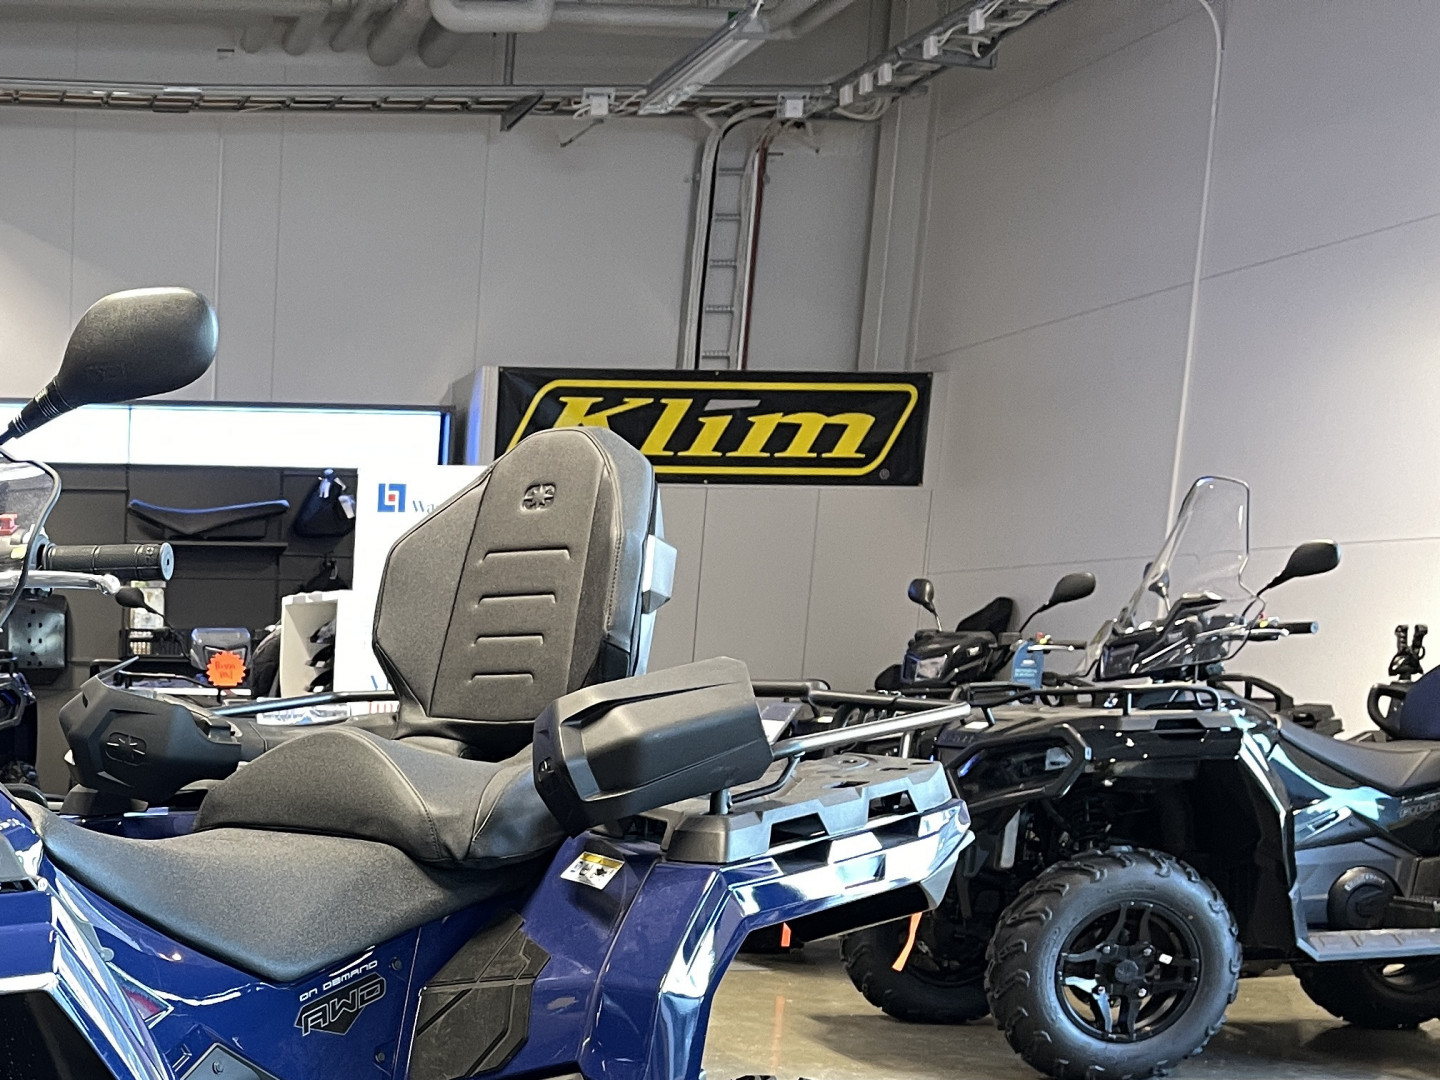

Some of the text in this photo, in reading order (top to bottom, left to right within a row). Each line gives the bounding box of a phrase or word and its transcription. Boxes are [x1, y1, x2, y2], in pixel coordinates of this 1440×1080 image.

[299, 960, 378, 1002] ON DEMAND
[302, 976, 387, 1036] AWD
